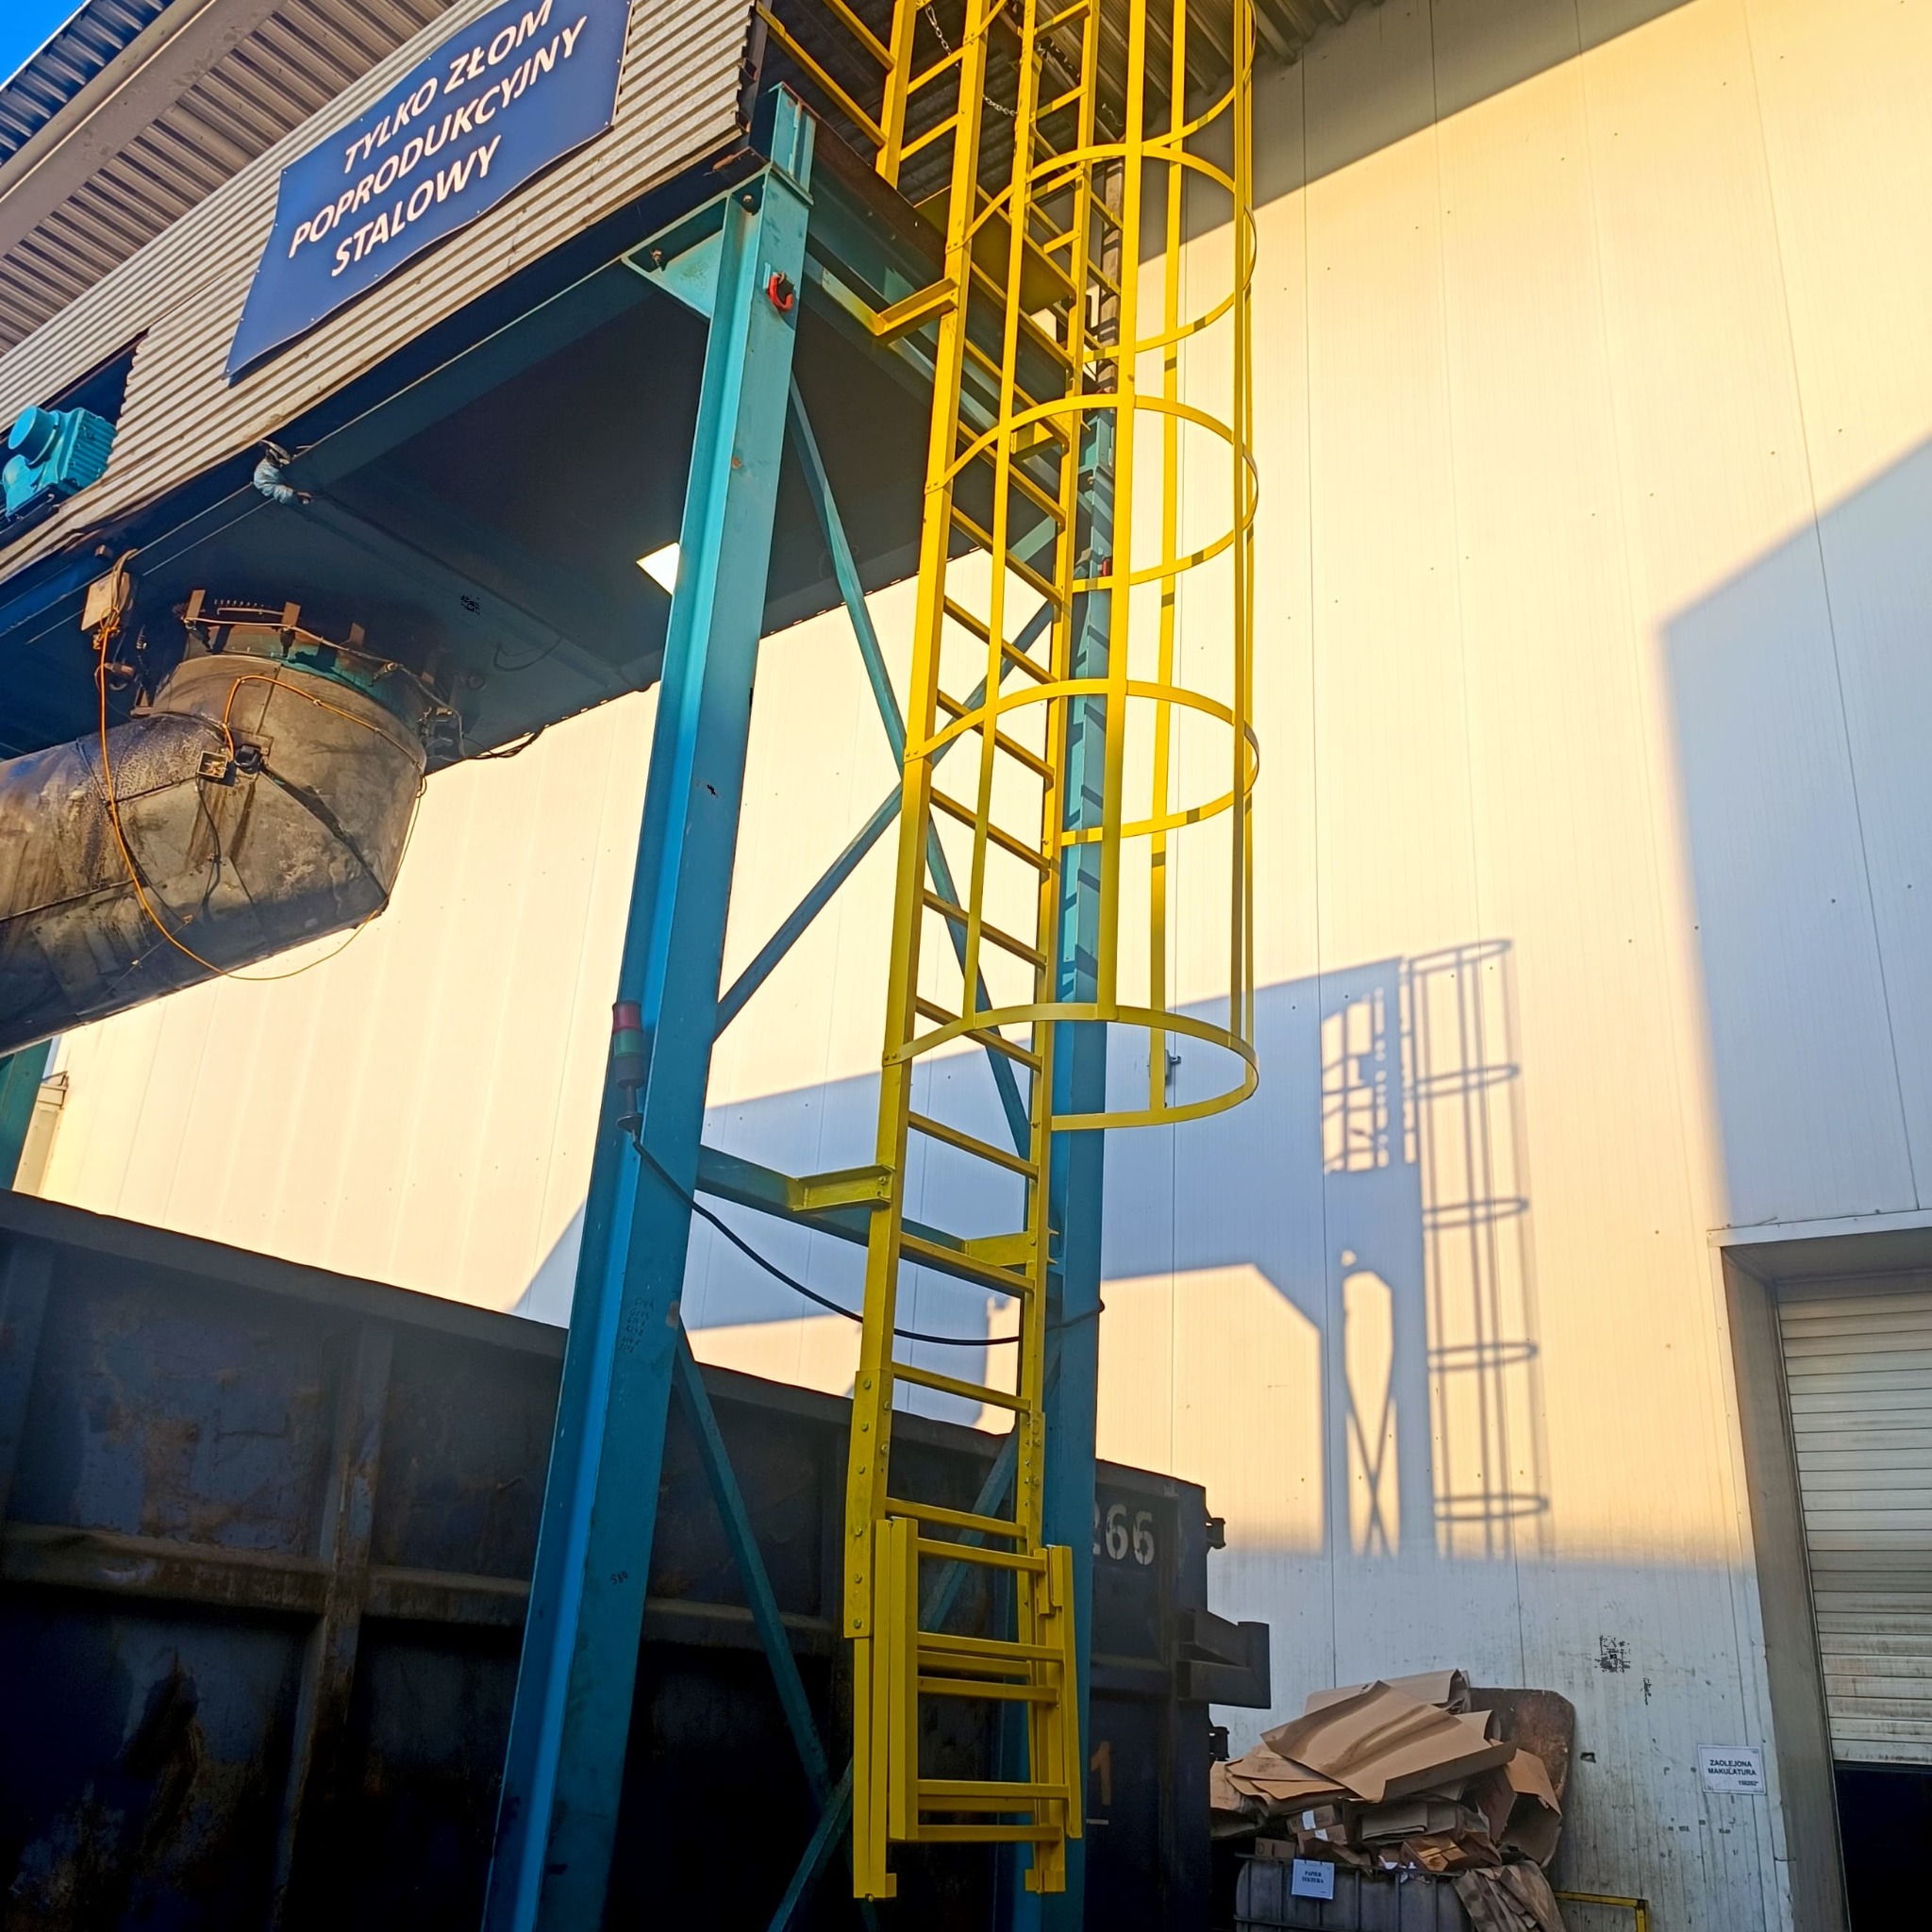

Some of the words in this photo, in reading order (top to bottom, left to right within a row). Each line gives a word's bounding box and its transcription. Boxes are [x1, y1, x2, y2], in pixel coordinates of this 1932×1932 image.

[288, 15, 588, 258] POPRODUKCYJNY
[344, 77, 438, 174] TYLKO
[443, 0, 554, 94] ZŁOM
[331, 135, 502, 276] STALOWY
[1709, 1759, 1753, 1768] ZAOLEJONA
